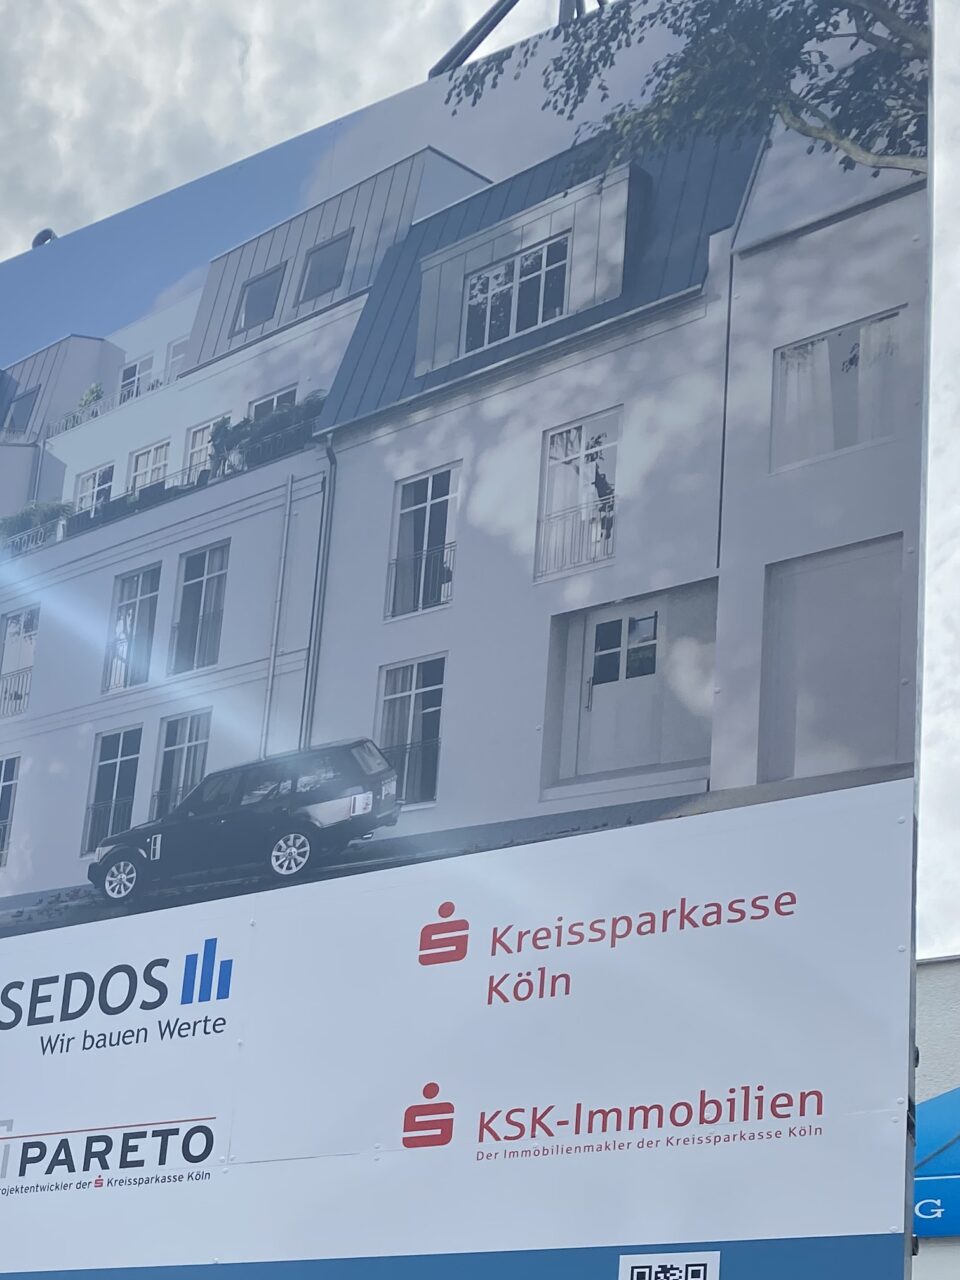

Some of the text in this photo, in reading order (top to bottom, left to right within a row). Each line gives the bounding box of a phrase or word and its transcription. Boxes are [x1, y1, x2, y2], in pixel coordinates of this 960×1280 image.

[490, 890, 797, 957] Kreissparkasse
[487, 966, 572, 1006] Köln
[39, 1015, 227, 1056] Wir bauen Werte
[477, 1084, 824, 1143] KSK-Immobilien
[18, 1125, 215, 1177] PARETO
[475, 1125, 824, 1161] Der Immobilienmakler der Kreissparkasse Köln
[75, 1180, 93, 1190] der
[106, 1173, 184, 1187] Kreissparkasse
[187, 1170, 211, 1182] Köln
